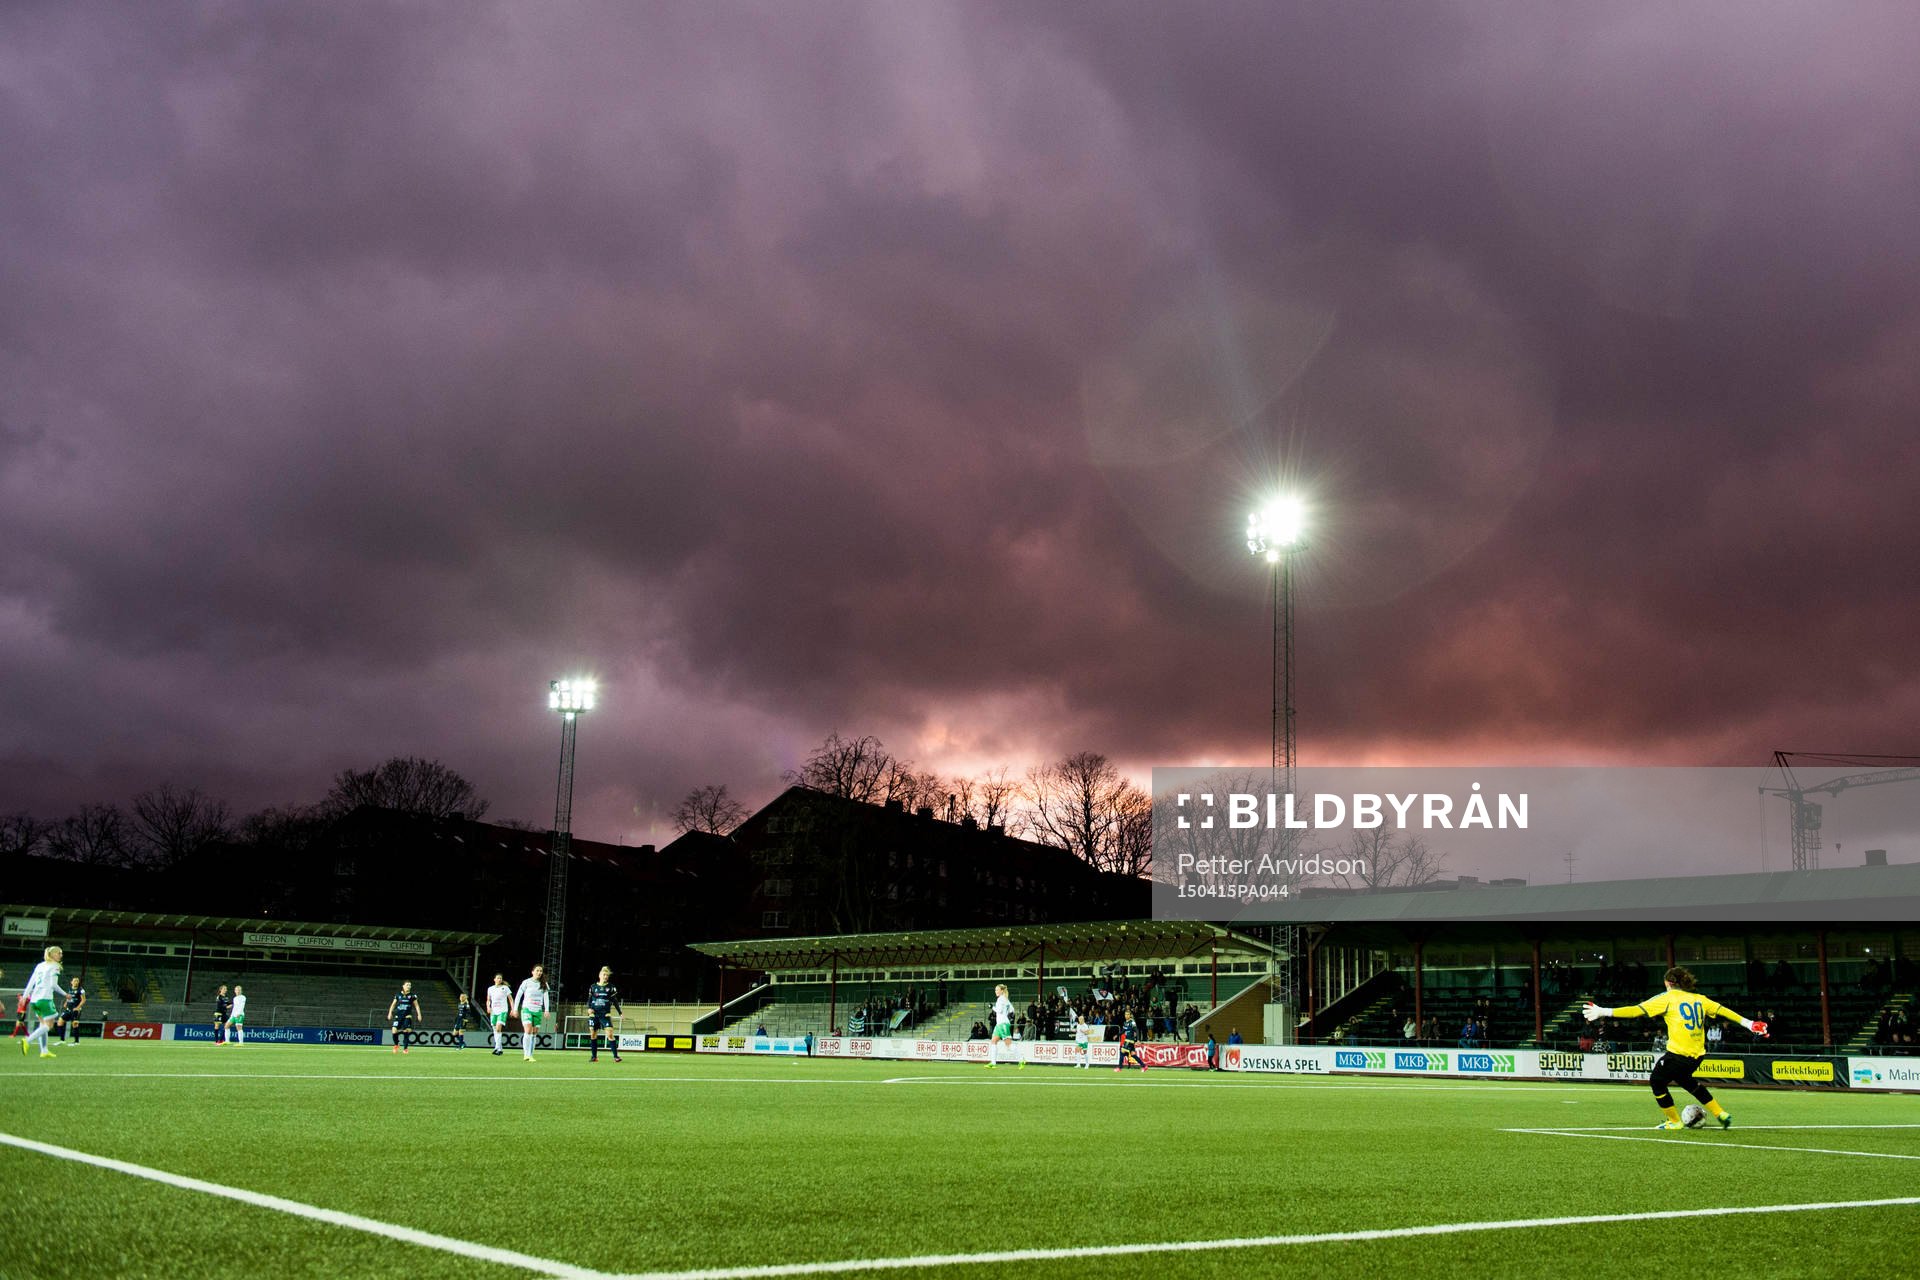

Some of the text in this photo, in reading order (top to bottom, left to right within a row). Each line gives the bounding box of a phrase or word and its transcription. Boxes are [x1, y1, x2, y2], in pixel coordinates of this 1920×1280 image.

[249, 934, 287, 944] CLIFFTON
[297, 936, 335, 946] CLIFFTON
[344, 939, 380, 949] CLIFFTON
[390, 941, 425, 951] CLIFFTON
[1679, 1001, 1705, 1030] 90
[184, 1028, 203, 1037] Hos
[335, 1031, 373, 1043] Wihlborgs
[622, 1038, 642, 1047] Deloitte
[1156, 1047, 1179, 1063] CITY
[1339, 1054, 1363, 1066] MKB
[1243, 1057, 1322, 1070] SVENSKA SPEL
[1398, 1056, 1424, 1067] MKB
[1462, 1057, 1489, 1069] MKB
[1538, 1052, 1585, 1071] SPORT
[1607, 1053, 1655, 1073] SPORT
[1775, 1065, 1830, 1077] arkitektkopia
